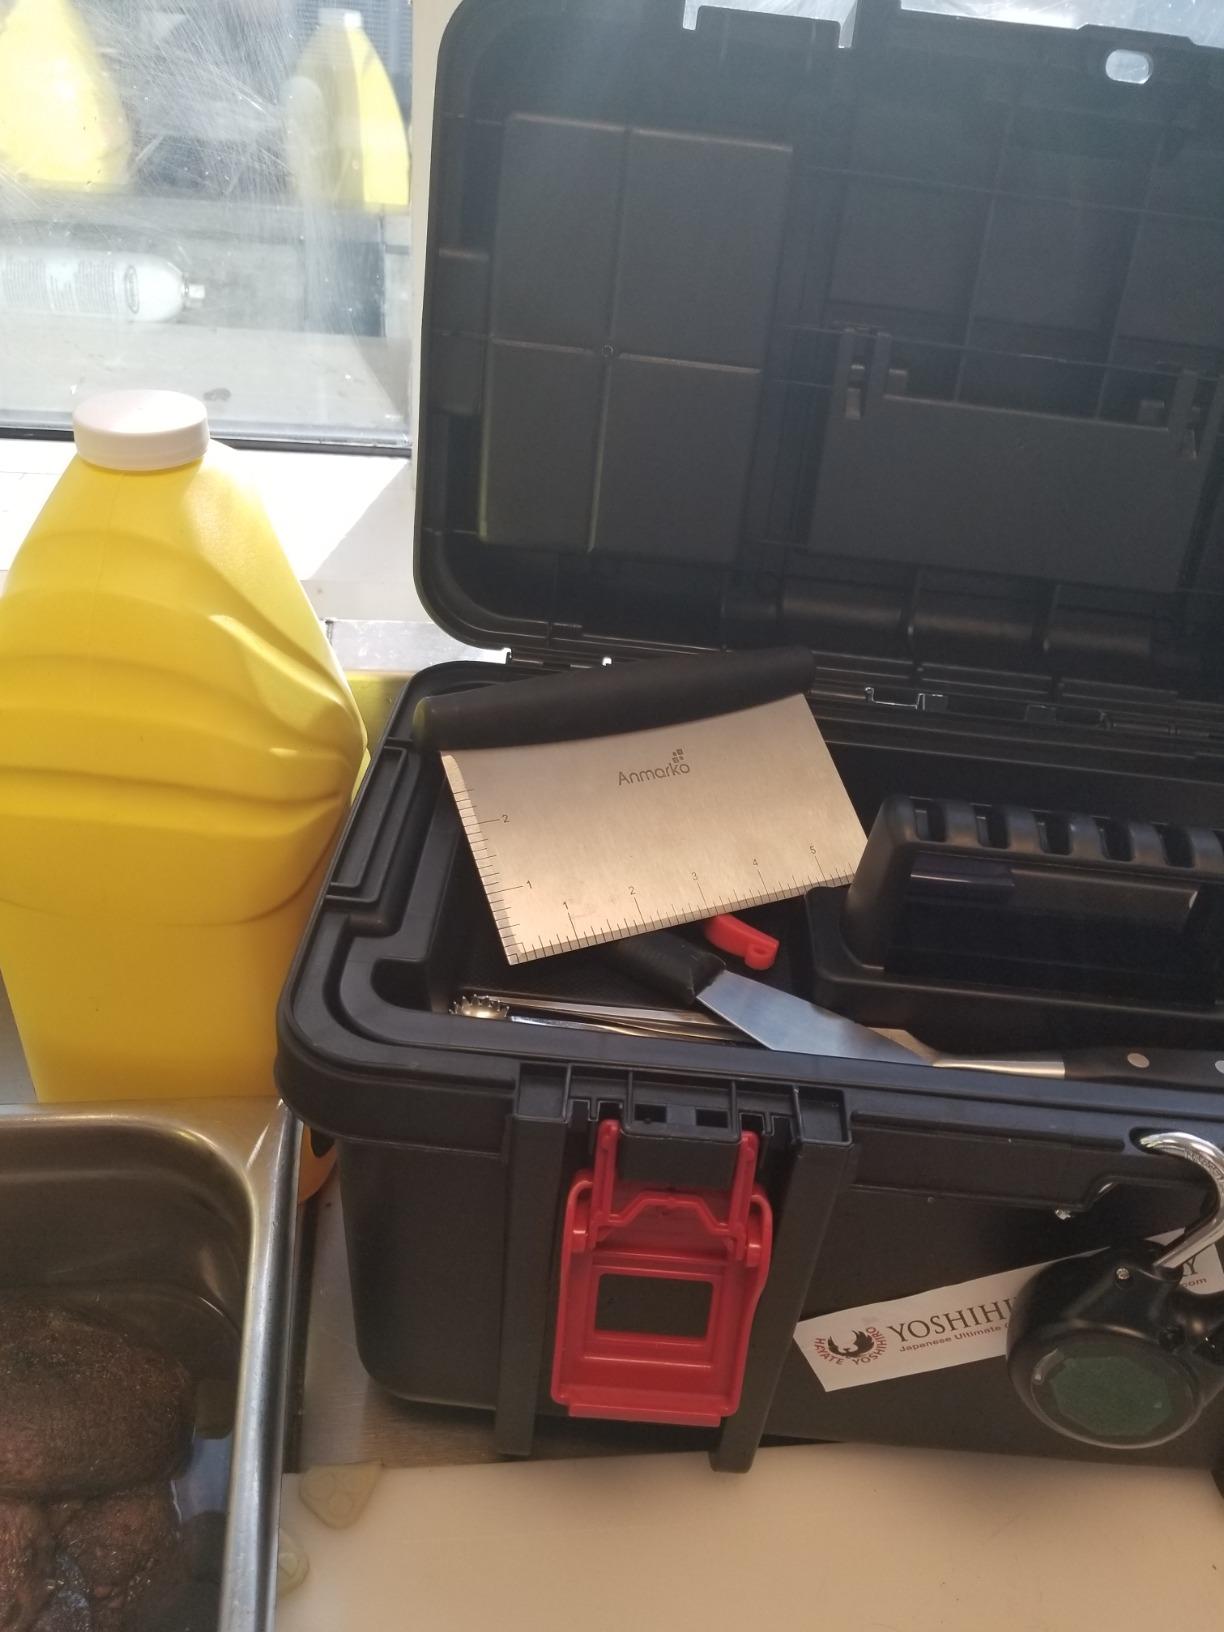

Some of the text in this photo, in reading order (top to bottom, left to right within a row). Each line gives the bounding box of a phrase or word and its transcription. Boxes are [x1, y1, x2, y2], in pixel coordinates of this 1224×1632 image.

[618, 762, 691, 786] Anmarko
[502, 814, 511, 823] 2
[526, 880, 533, 889] 1
[563, 845, 817, 910] 1 2 3 4 5
[886, 1298, 1012, 1343] YOSHIHI
[814, 1337, 845, 1365] HAYATE
[852, 1326, 888, 1365] YOSHIHIRO
[899, 1326, 1002, 1353] Japanese Ultimate
